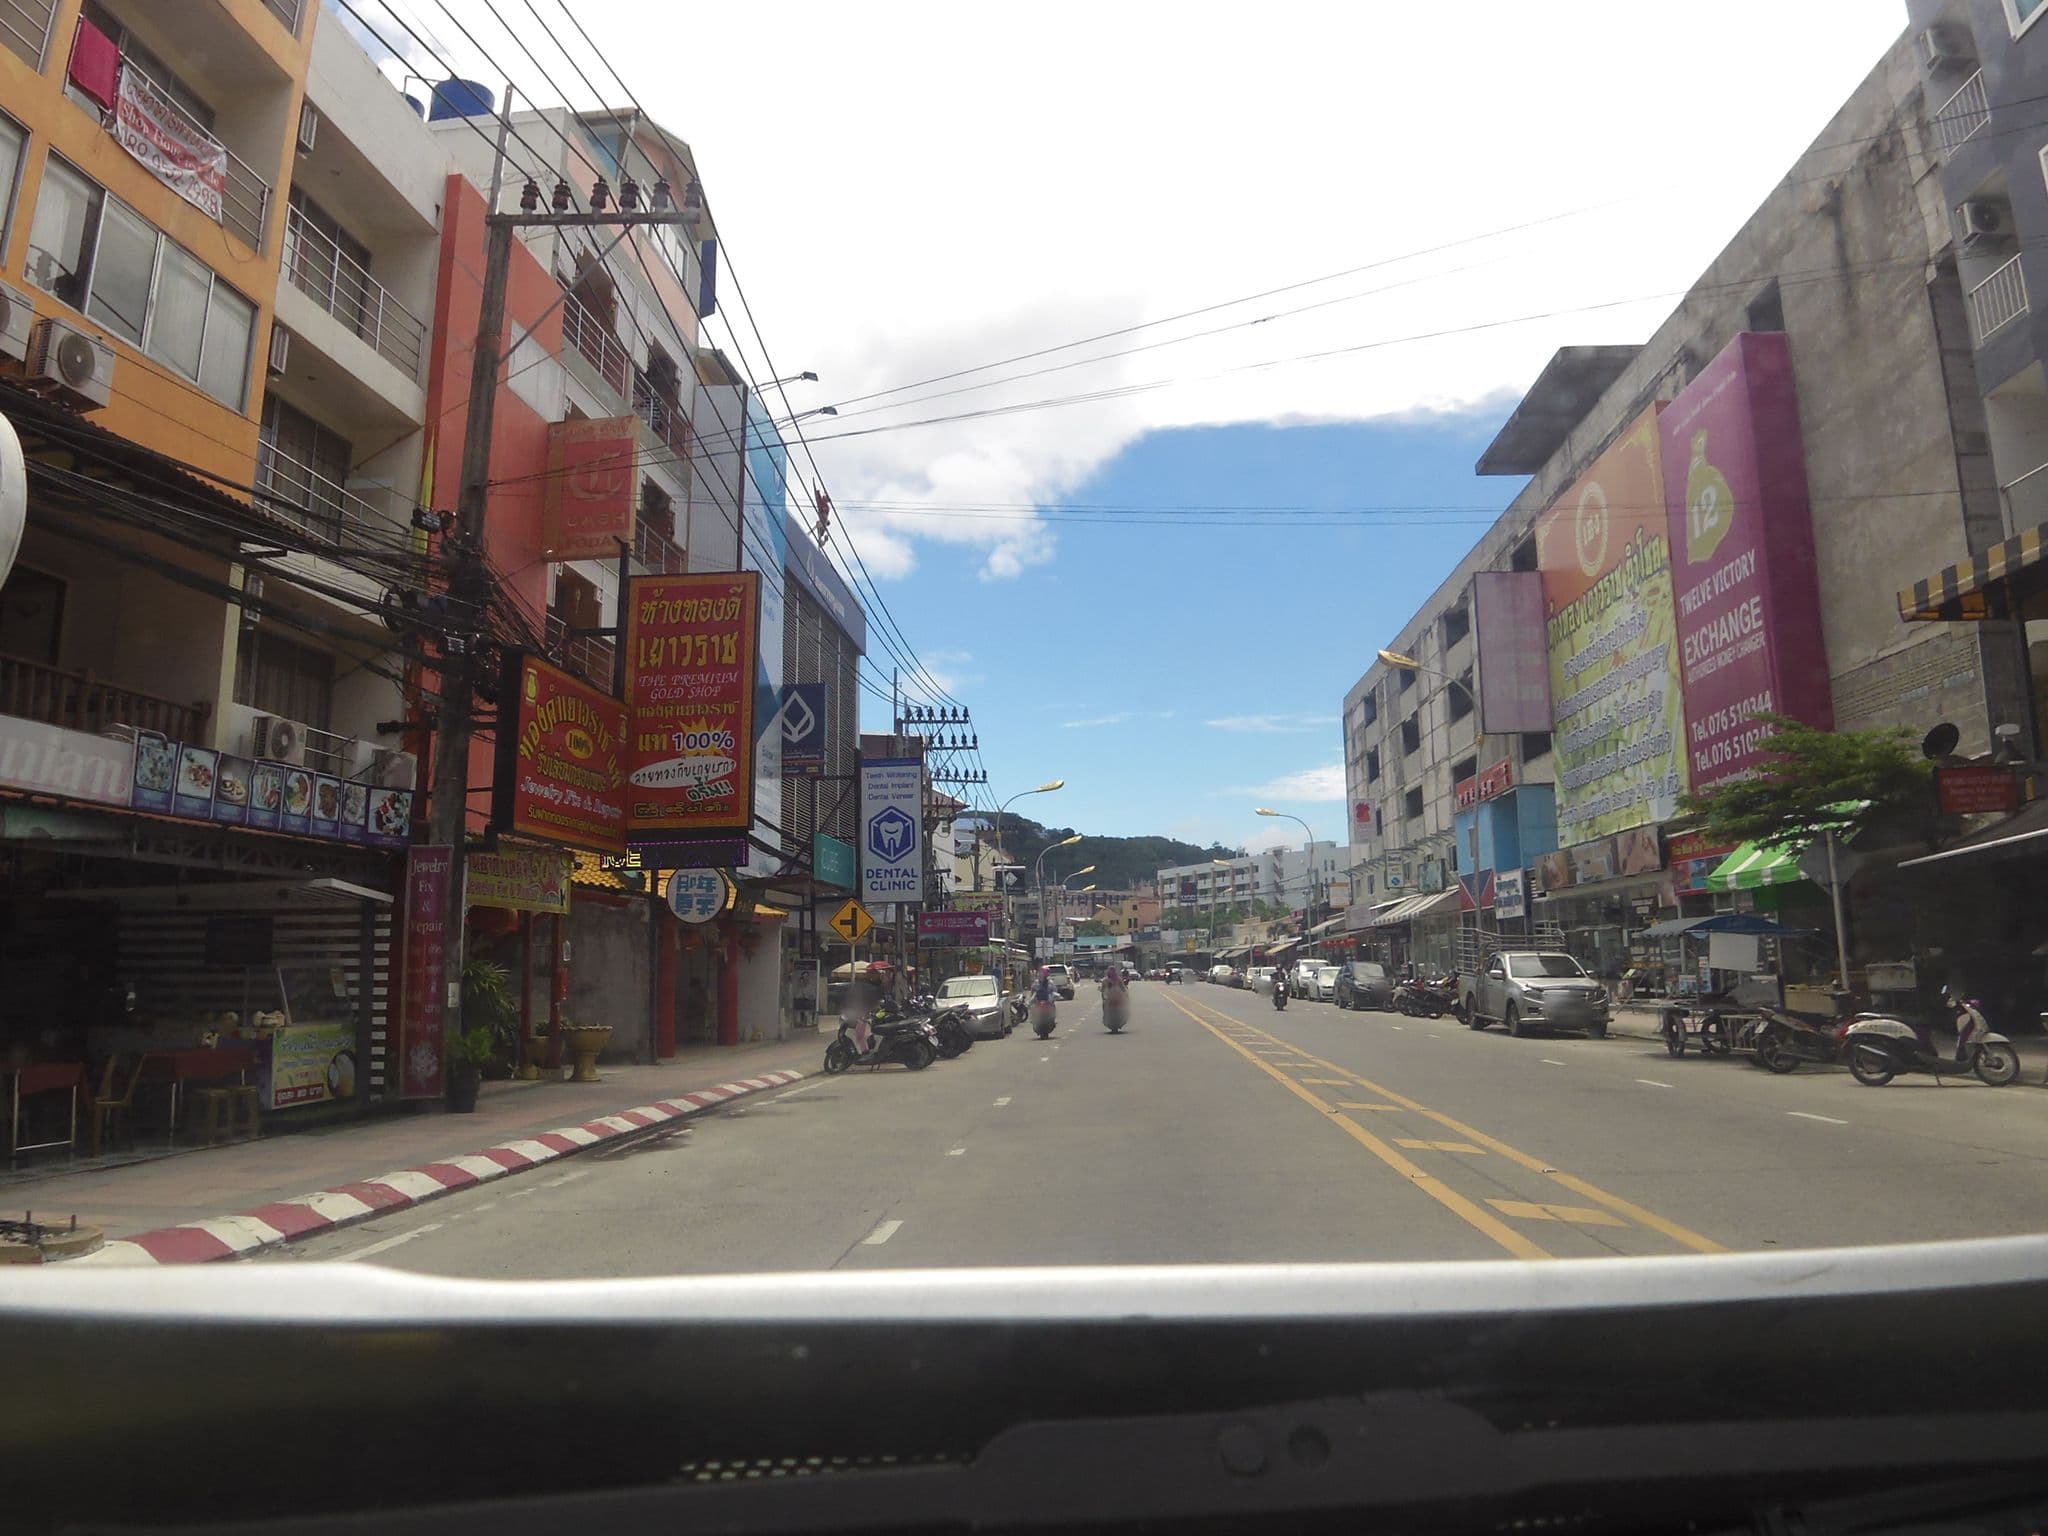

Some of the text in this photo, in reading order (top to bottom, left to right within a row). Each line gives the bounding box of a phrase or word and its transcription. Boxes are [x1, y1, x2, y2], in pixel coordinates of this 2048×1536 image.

[122, 103, 149, 134] Shop
[1680, 548, 1756, 617] TWELVE VICTORY
[1684, 596, 1764, 666] EXCHANGE
[638, 632, 739, 670] เยาวราช
[1737, 632, 1765, 660] CHANGER
[639, 671, 739, 687] THE PREMIUM
[650, 685, 721, 702] GOLD SHOP
[1691, 718, 1708, 742] Tel.
[1708, 709, 1728, 735] 076
[672, 730, 735, 752] 100%
[1694, 748, 1712, 772] Tel.
[1711, 739, 1732, 765] 076
[411, 858, 448, 876] Jewelry
[866, 868, 918, 880] DENTAL
[418, 880, 433, 892] Fix
[870, 880, 916, 891] CLINIC
[422, 900, 432, 913] &
[411, 920, 445, 935] epair
